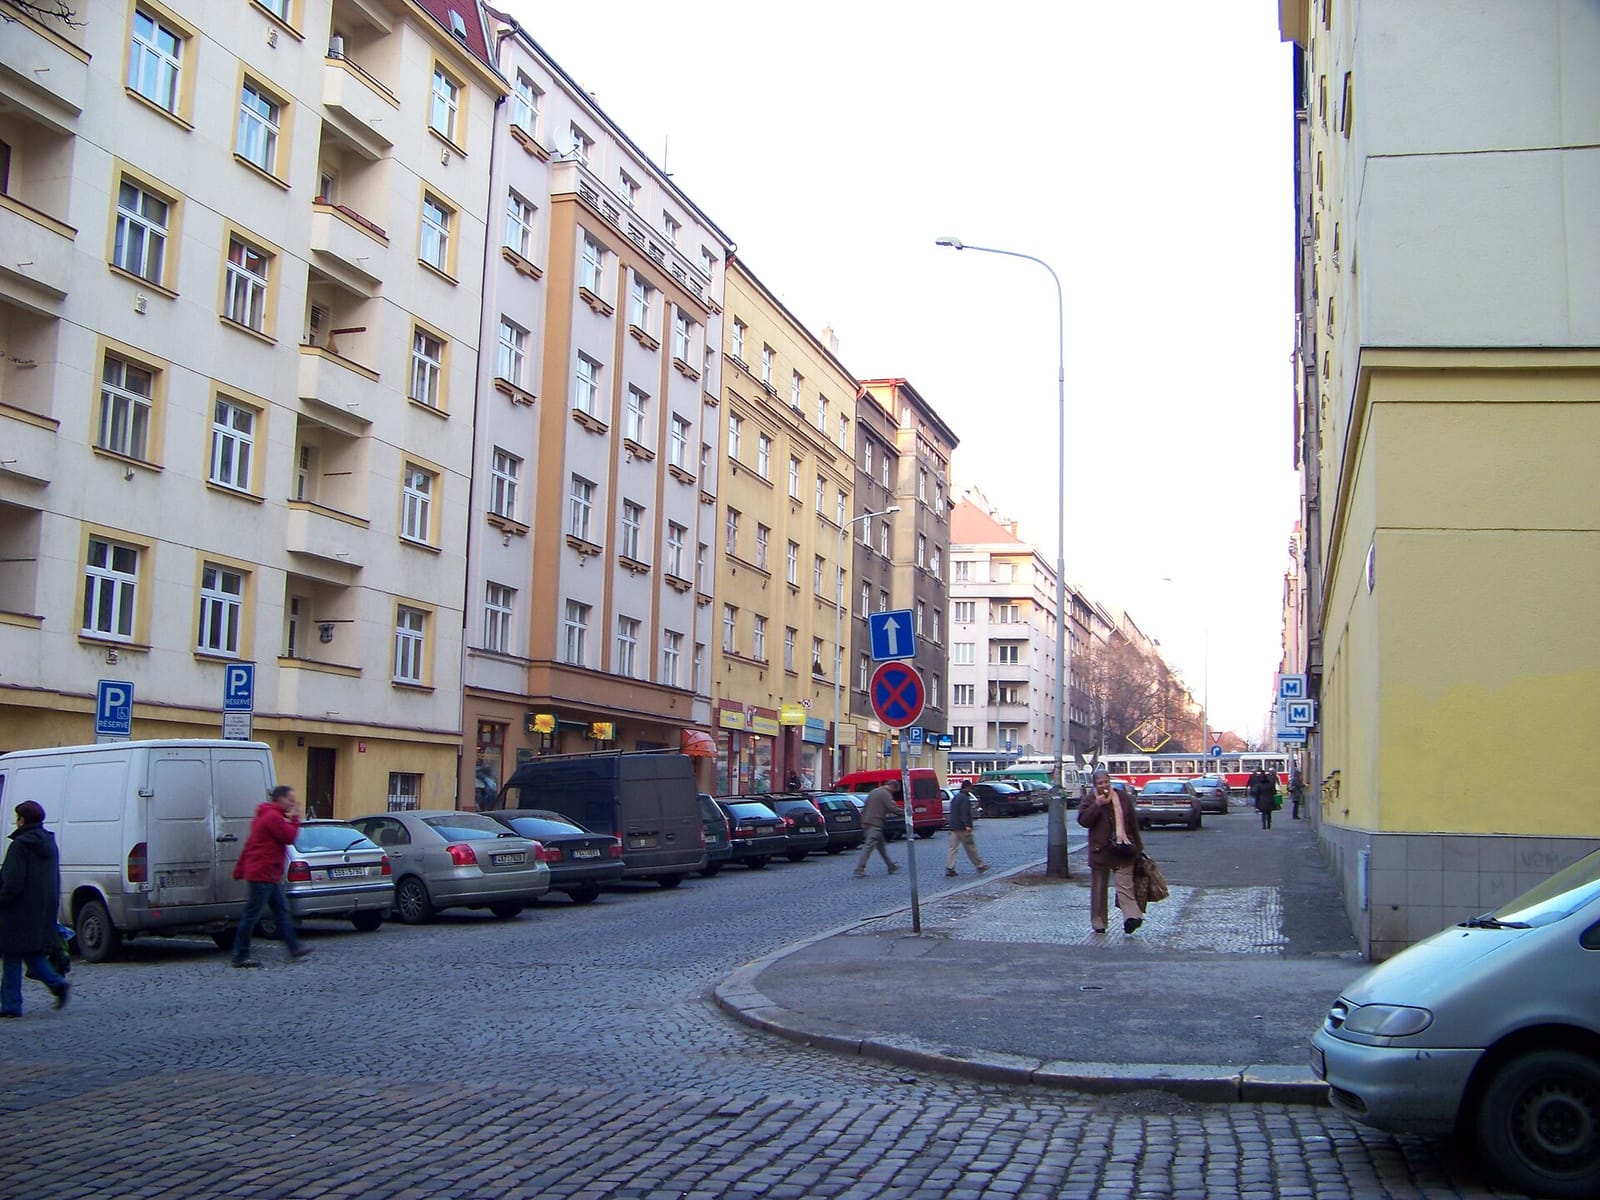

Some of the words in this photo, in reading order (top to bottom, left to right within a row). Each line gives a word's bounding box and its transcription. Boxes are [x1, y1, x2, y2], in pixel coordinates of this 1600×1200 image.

[231, 670, 247, 696] P
[1286, 683, 1297, 693] M
[105, 688, 125, 717] P
[1294, 708, 1306, 718] M
[912, 729, 920, 739] P
